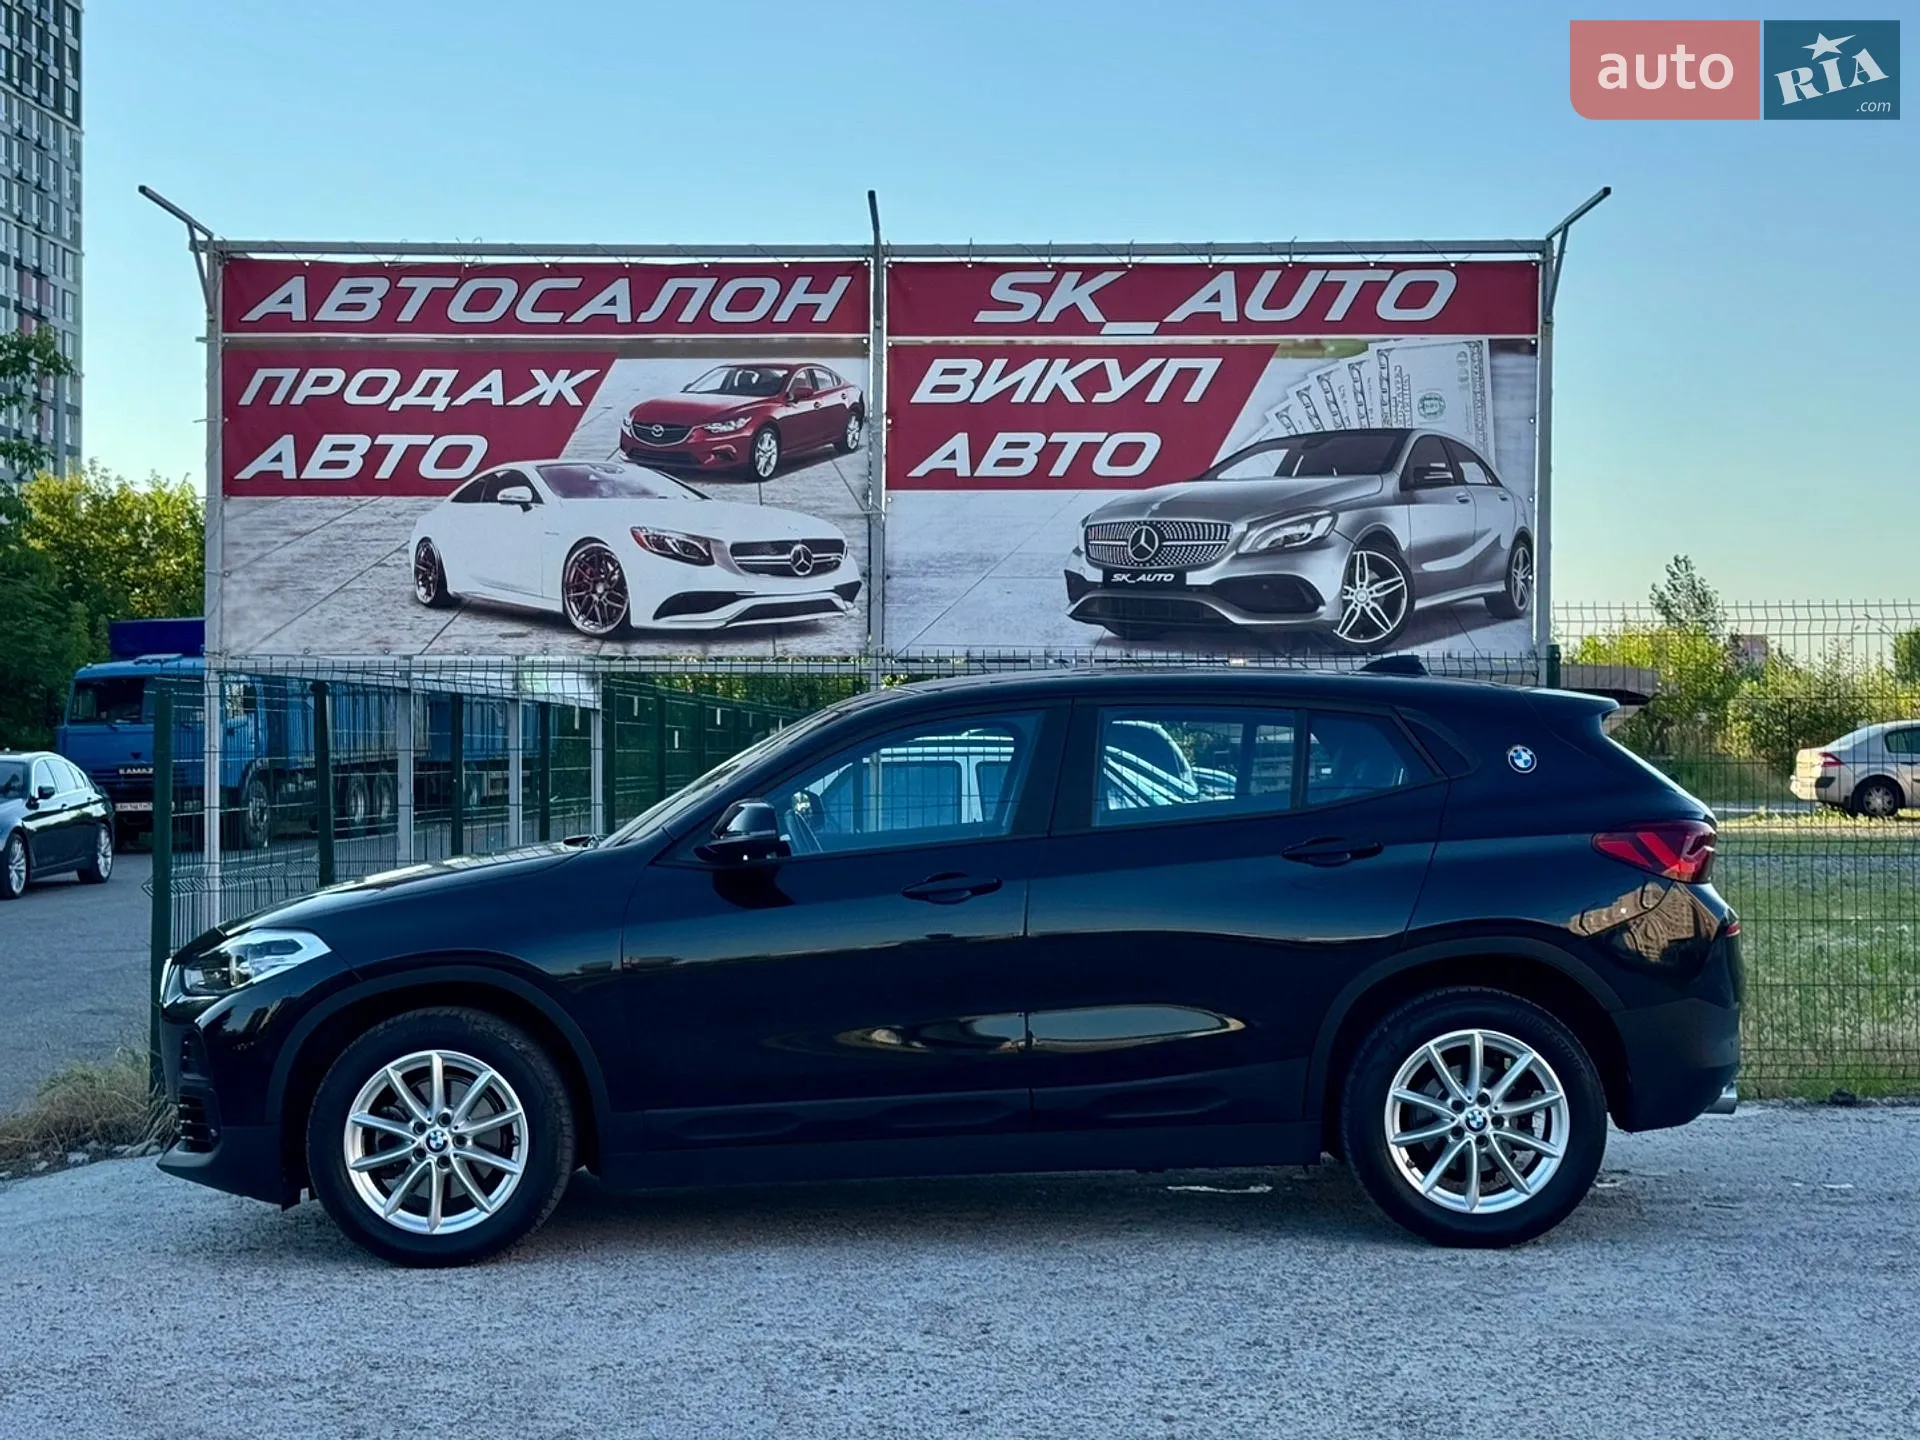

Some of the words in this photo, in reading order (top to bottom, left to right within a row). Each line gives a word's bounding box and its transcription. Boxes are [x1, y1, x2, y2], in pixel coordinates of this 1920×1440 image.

[240, 275, 853, 324] АВТОСАЛОН
[973, 268, 1458, 335] SK_AUTO
[238, 367, 601, 413] ПРОДАЖ
[909, 357, 1224, 404] ВИКУП
[233, 433, 488, 481] АВТО
[906, 431, 1163, 478] АВТО
[1110, 572, 1176, 584] SK_AUTO
